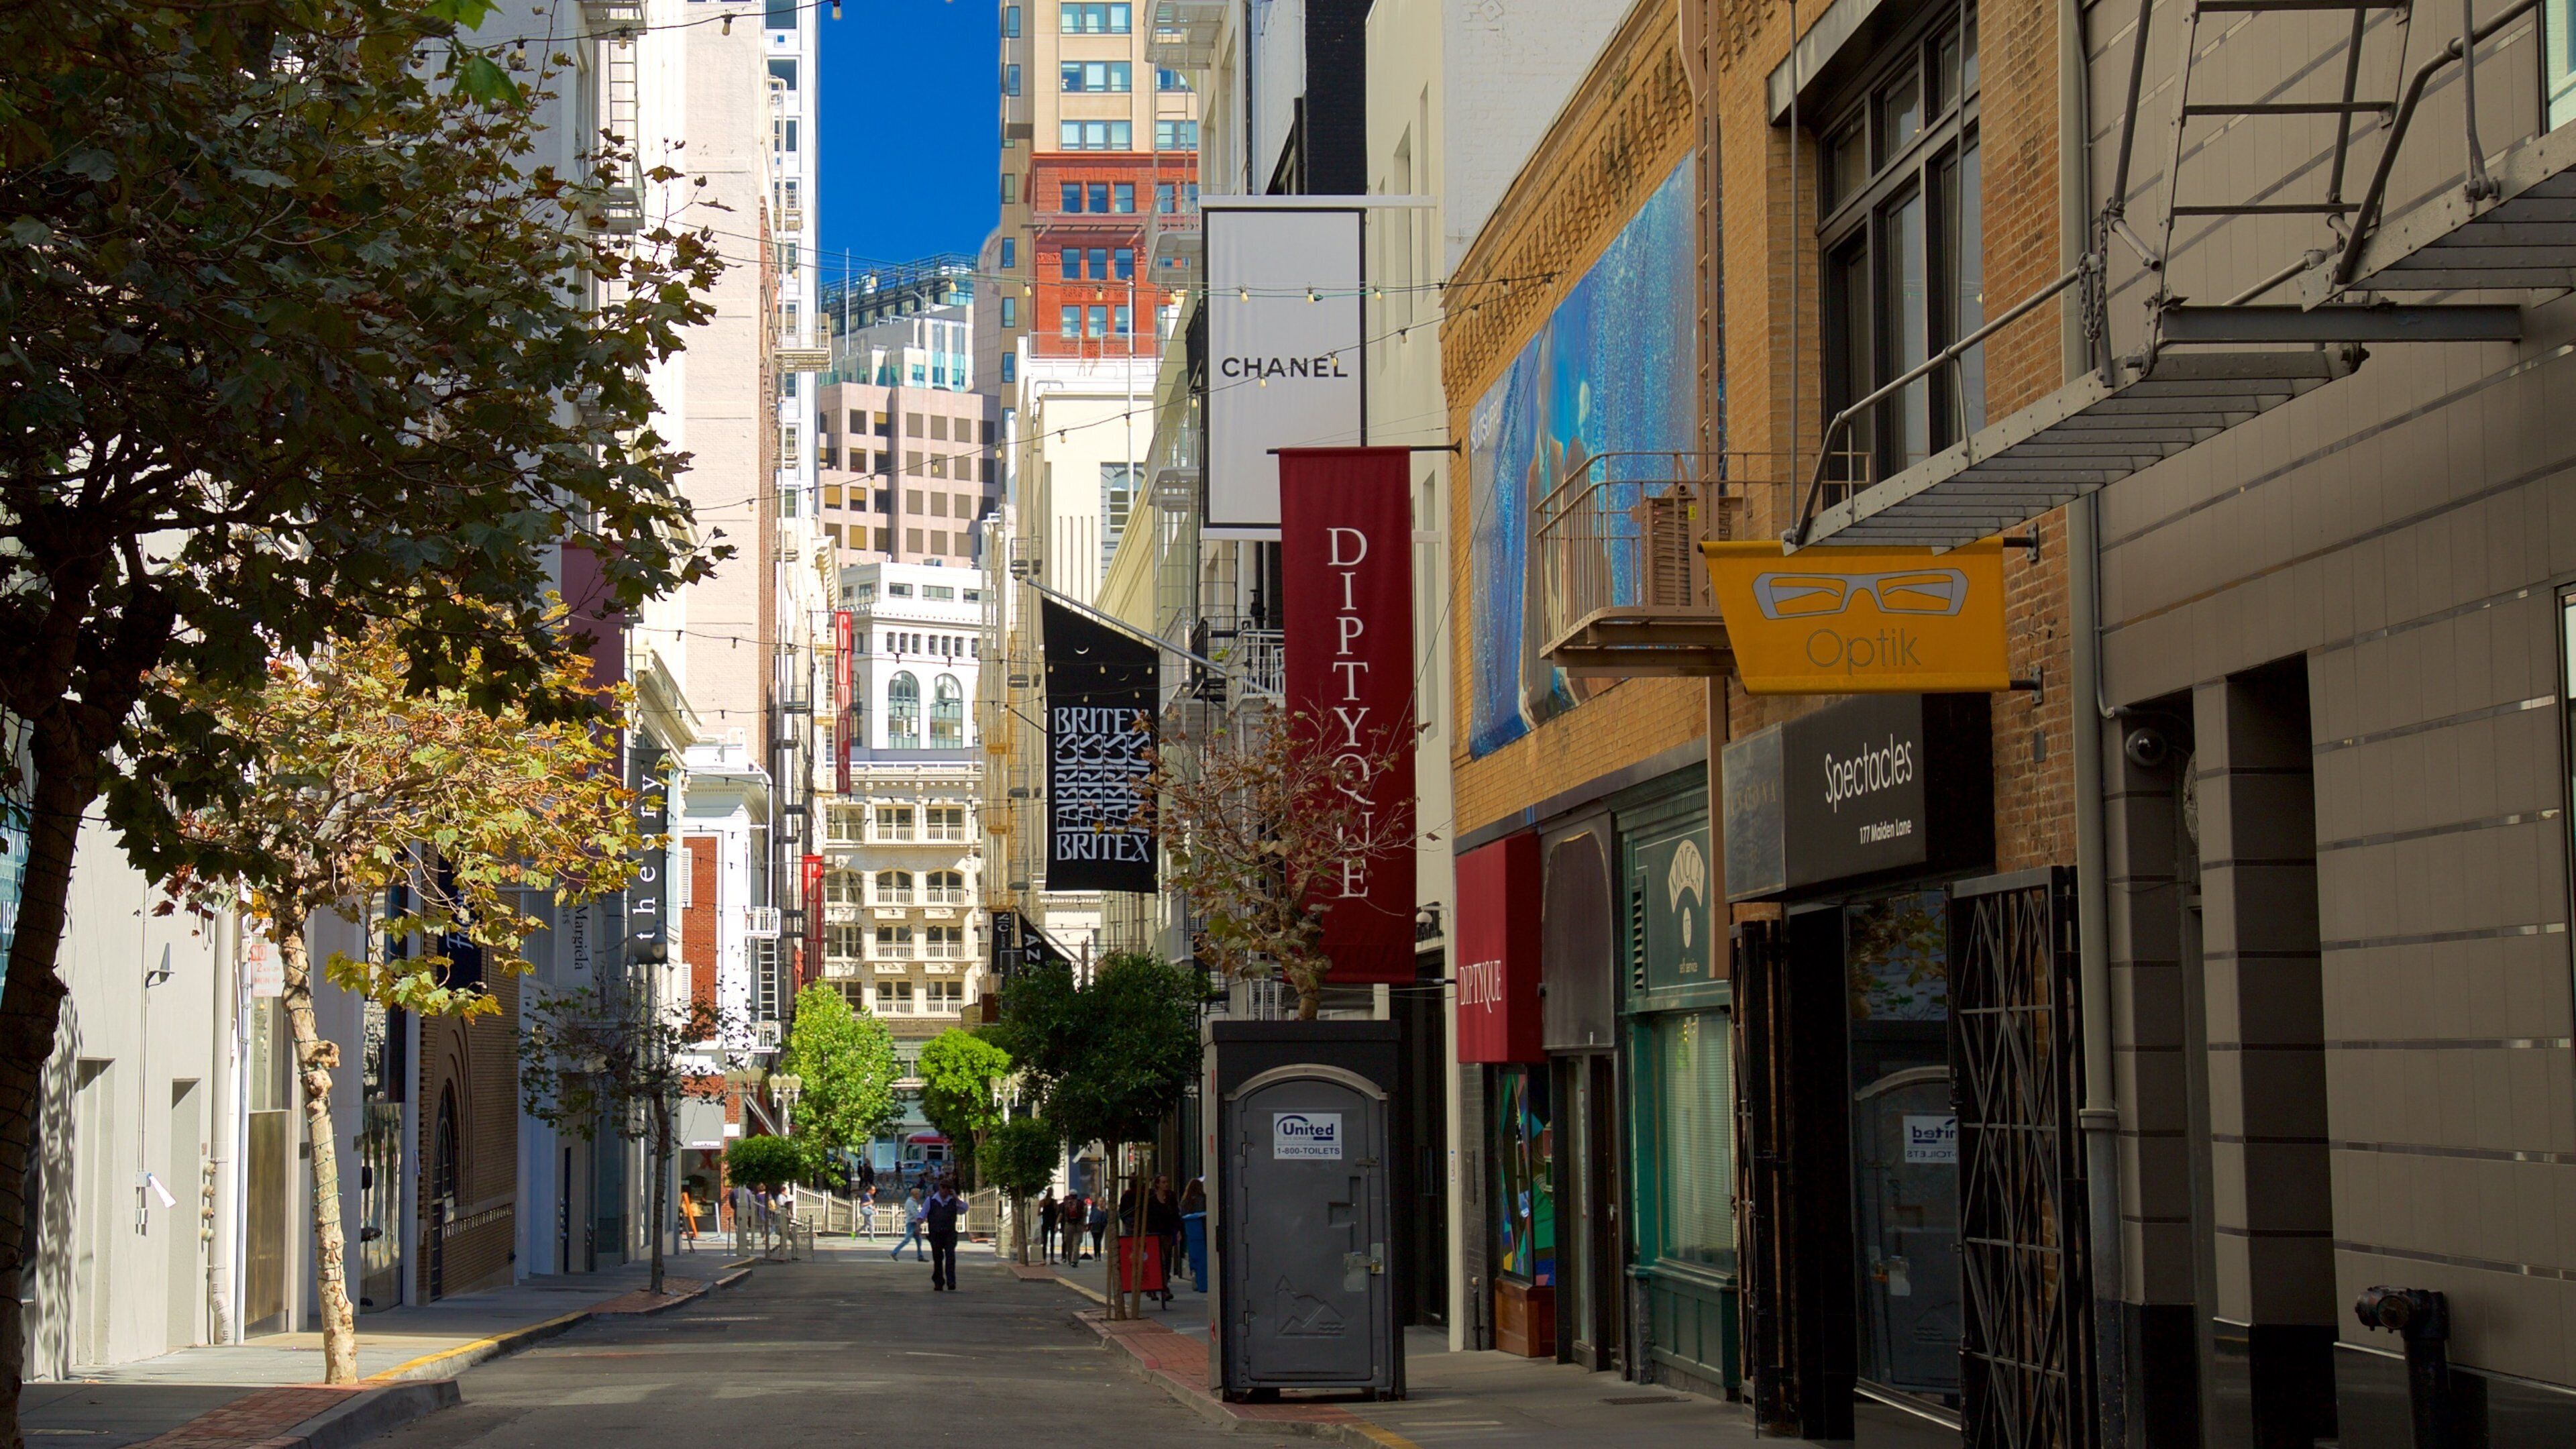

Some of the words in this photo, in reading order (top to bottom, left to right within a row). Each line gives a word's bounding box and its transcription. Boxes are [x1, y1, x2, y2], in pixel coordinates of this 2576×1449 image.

[1221, 357, 1348, 378] CHANEL
[1806, 628, 1921, 676] Optik
[1054, 707, 1150, 736] BRITEX
[1326, 527, 1375, 898] DIPTYQUE
[1055, 733, 1078, 833] FABRICS
[1079, 733, 1104, 833] FABRICS
[1104, 733, 1128, 833] FABRICS
[1825, 733, 1913, 813] Spectacles
[633, 774, 665, 939] theory
[1057, 834, 1150, 863] BRITEX
[1860, 825, 1870, 845] 177
[1871, 820, 1894, 842] Maiden
[1896, 818, 1911, 837] Lane
[252, 946, 266, 960] NO
[571, 906, 588, 970] Margiela
[1460, 960, 1501, 1014] DIPTYQUE
[1283, 1122, 1334, 1136] United
